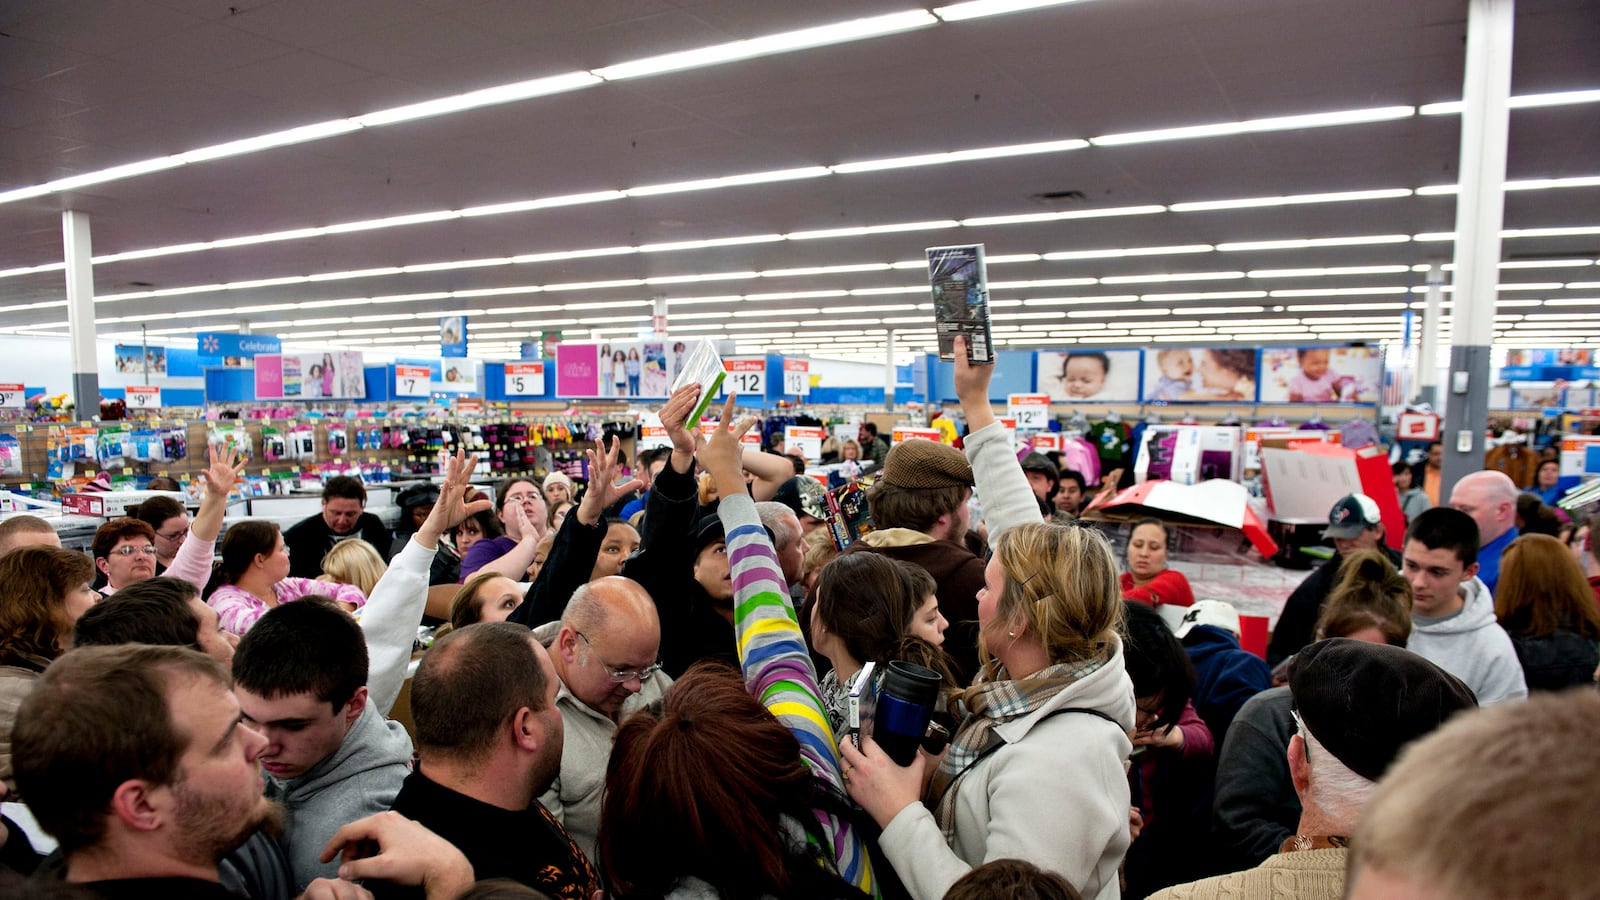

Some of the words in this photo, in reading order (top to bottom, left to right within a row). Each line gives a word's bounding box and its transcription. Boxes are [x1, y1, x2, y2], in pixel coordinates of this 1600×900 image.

[403, 379, 415, 393] $7
[512, 377, 524, 393] $5
[734, 374, 760, 392] $12
